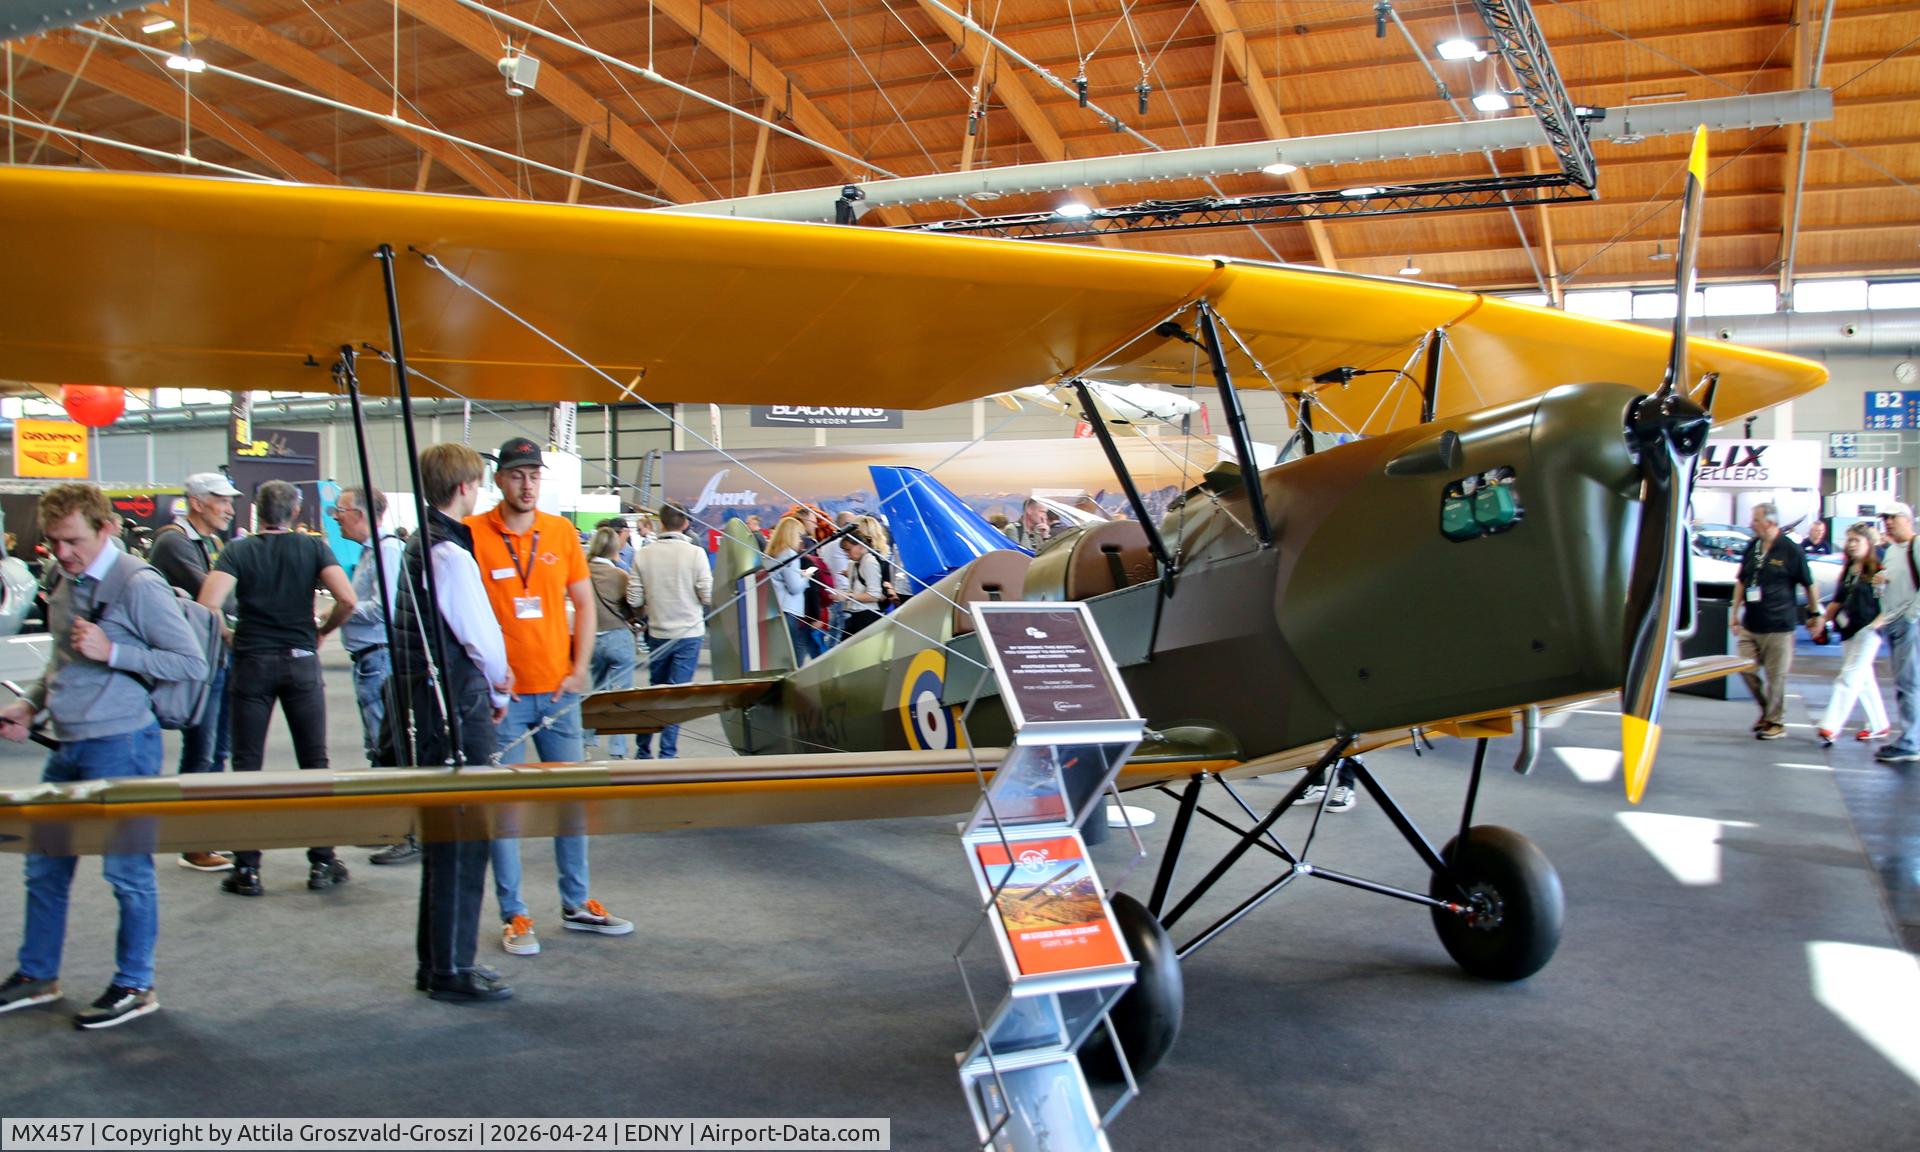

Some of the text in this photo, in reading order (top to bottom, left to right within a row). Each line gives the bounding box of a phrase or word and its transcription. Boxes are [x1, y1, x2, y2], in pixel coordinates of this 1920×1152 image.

[1874, 391, 1904, 409] B2
[808, 417, 847, 425] SWEDEN
[21, 431, 82, 443] GROPPO
[1701, 445, 1769, 467] LIX
[1699, 467, 1769, 481] ELLERS
